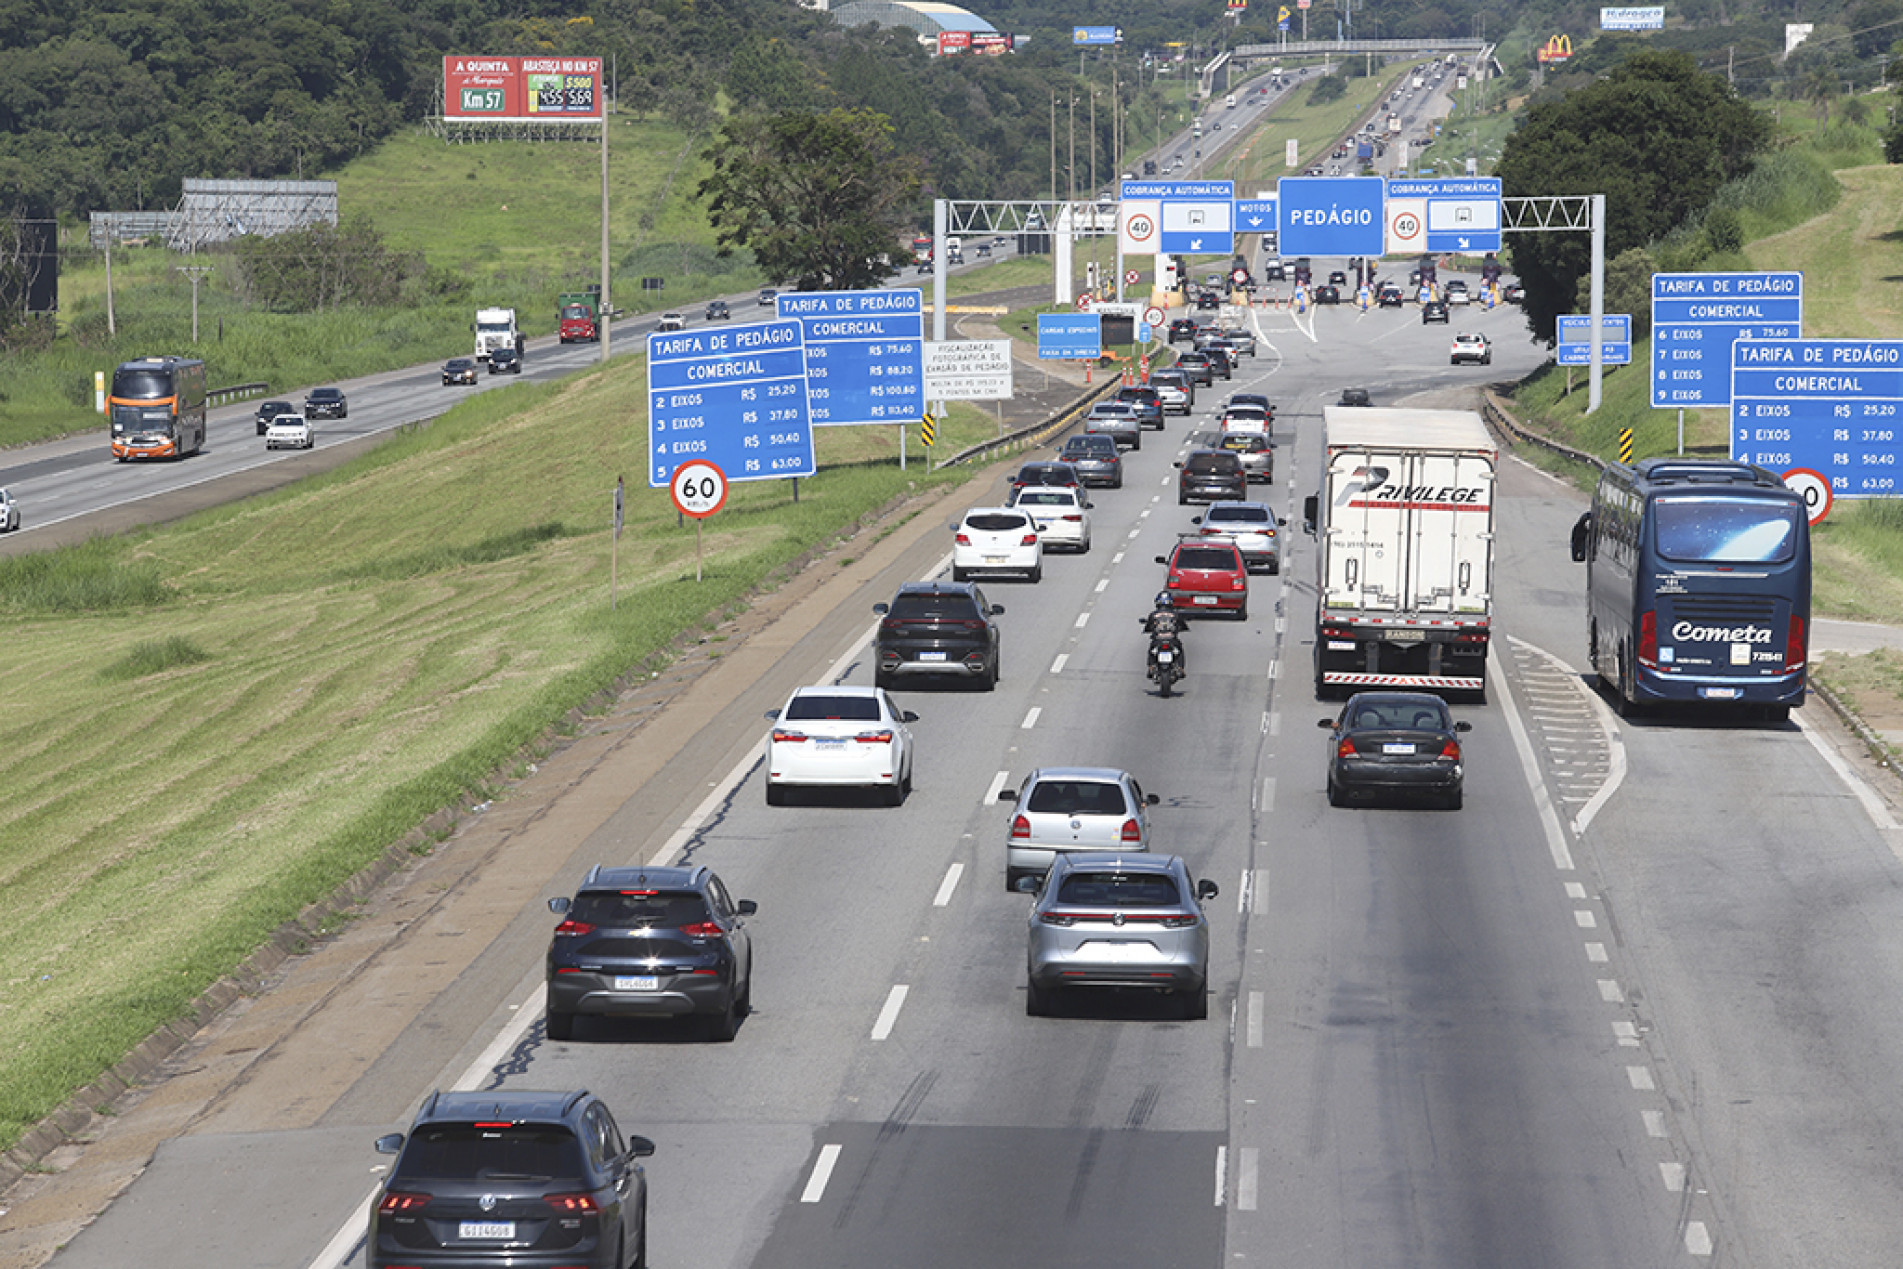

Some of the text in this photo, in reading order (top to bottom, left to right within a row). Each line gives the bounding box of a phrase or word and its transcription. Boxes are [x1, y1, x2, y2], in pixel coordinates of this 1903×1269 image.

[457, 61, 509, 71] A QUINTA
[464, 90, 501, 108] Km 57
[1124, 184, 1230, 196] COBRANÇA AUTOMÁTICA
[1391, 182, 1497, 194] COBRANÇA AUTOMÁTICA
[1240, 204, 1272, 212] MOTOS
[1291, 204, 1372, 225] PEDÁGIO
[1132, 222, 1149, 232] 40
[1398, 221, 1414, 231] 40
[1659, 276, 1794, 292] TARIFA DE PEDÁGIO
[783, 294, 915, 312] TARIFA DE PEDÁGIO
[1688, 305, 1763, 318] COMERCIAL
[813, 322, 885, 335] COMERCIAL
[1658, 330, 1667, 340] 6
[1672, 330, 1702, 340] EIXOS
[656, 327, 794, 356] TARIFA DE PEDÁGIO
[869, 346, 882, 356] R$
[1659, 350, 1702, 360] 7 EIXOS
[1741, 344, 1899, 363] TARIFA DE PEDÁGIO
[687, 360, 764, 379] COMERCIAL
[870, 366, 883, 376] R$
[1658, 370, 1702, 380] 8 EIXOS
[1775, 377, 1862, 391] COMERCIAL
[870, 386, 884, 397] R$
[1658, 390, 1702, 400] 9 EIXOS
[656, 398, 664, 408] 2
[671, 394, 703, 407] EIXOS
[740, 388, 757, 401] R$
[871, 405, 884, 417] R$
[1739, 405, 1750, 417] 2
[1756, 405, 1791, 417] EIXOS
[1834, 405, 1851, 418] R$
[657, 420, 666, 431] 3
[672, 416, 704, 430] EIXOS
[743, 412, 758, 424] R$
[1739, 429, 1748, 441] 3
[1756, 429, 1791, 441] EIXOS
[1834, 429, 1850, 441] R$
[658, 443, 667, 454] 4
[673, 440, 707, 454] EIXOS
[744, 435, 760, 448] R$
[745, 459, 760, 471] R$
[1738, 453, 1749, 464] 4
[1756, 453, 1792, 465] EIXOS
[1834, 453, 1850, 465] R$
[658, 466, 666, 478] 5
[682, 477, 715, 498] 60
[1334, 466, 1485, 506] PRIVILEGE
[1832, 477, 1849, 488] R$
[1804, 486, 1819, 507] 0
[1672, 621, 1771, 644] Cometa
